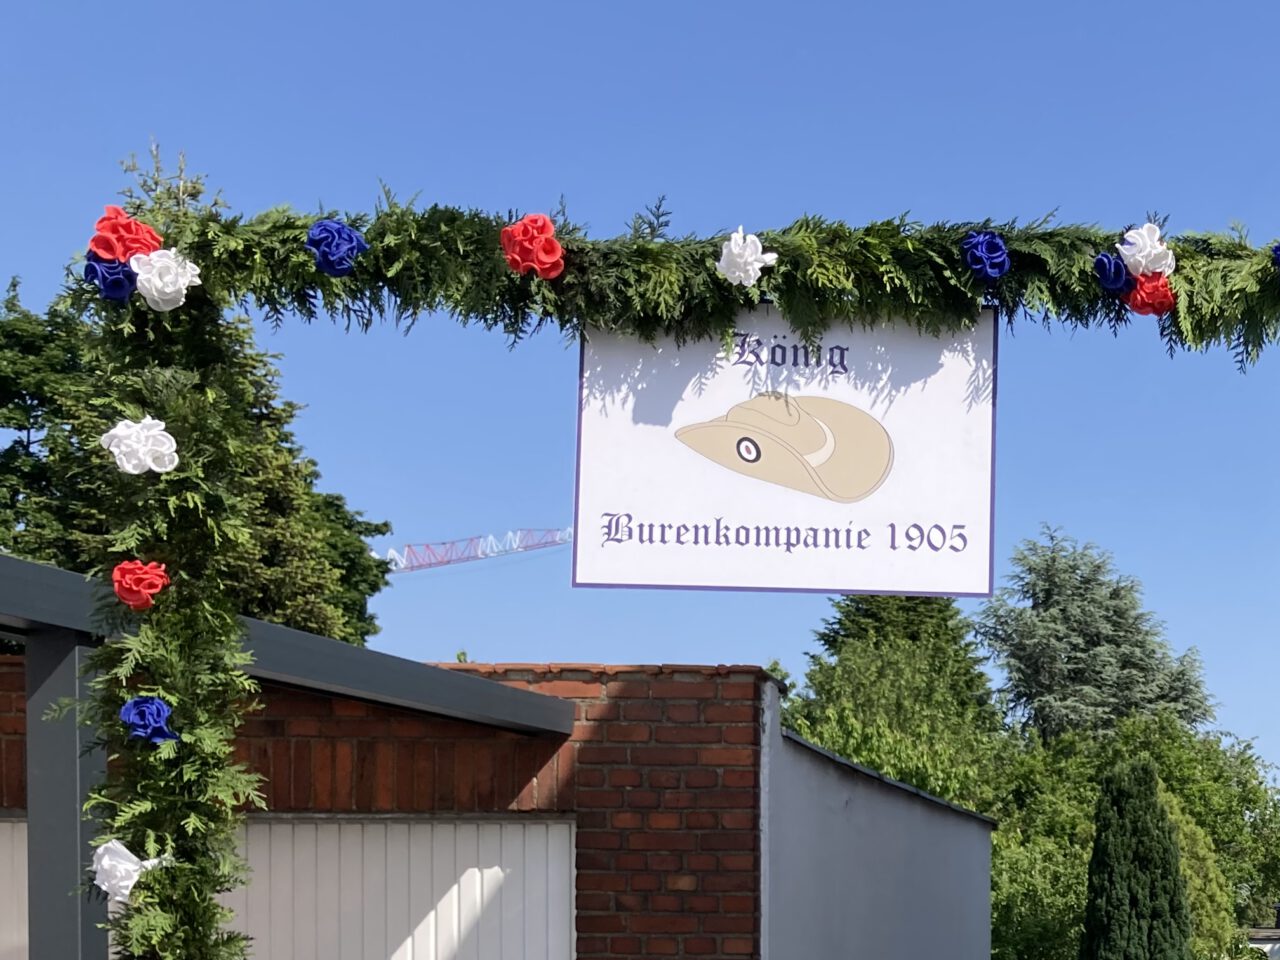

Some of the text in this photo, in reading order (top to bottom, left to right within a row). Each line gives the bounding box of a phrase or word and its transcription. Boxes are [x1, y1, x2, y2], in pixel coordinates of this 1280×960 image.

[732, 332, 849, 375] König
[601, 512, 968, 554] Burenkompanie 1905
